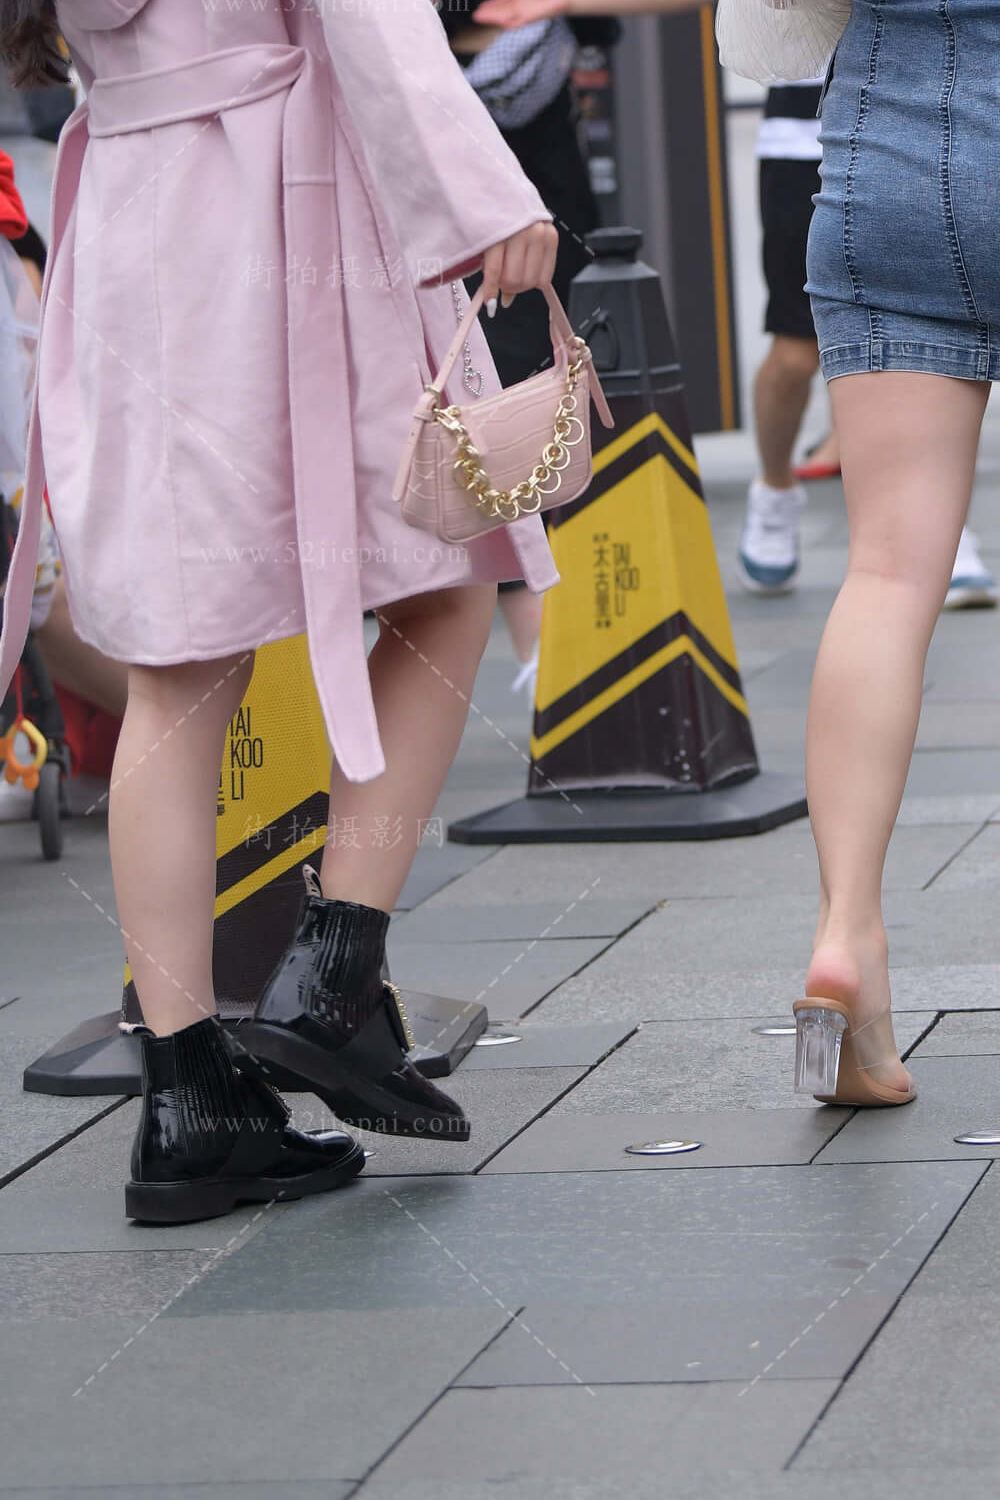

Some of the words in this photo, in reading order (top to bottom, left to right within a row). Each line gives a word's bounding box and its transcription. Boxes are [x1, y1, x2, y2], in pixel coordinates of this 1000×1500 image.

[613, 542, 630, 566] TAI
[615, 566, 640, 591] KOO
[230, 738, 264, 769] KOO
[231, 770, 244, 801] LI
